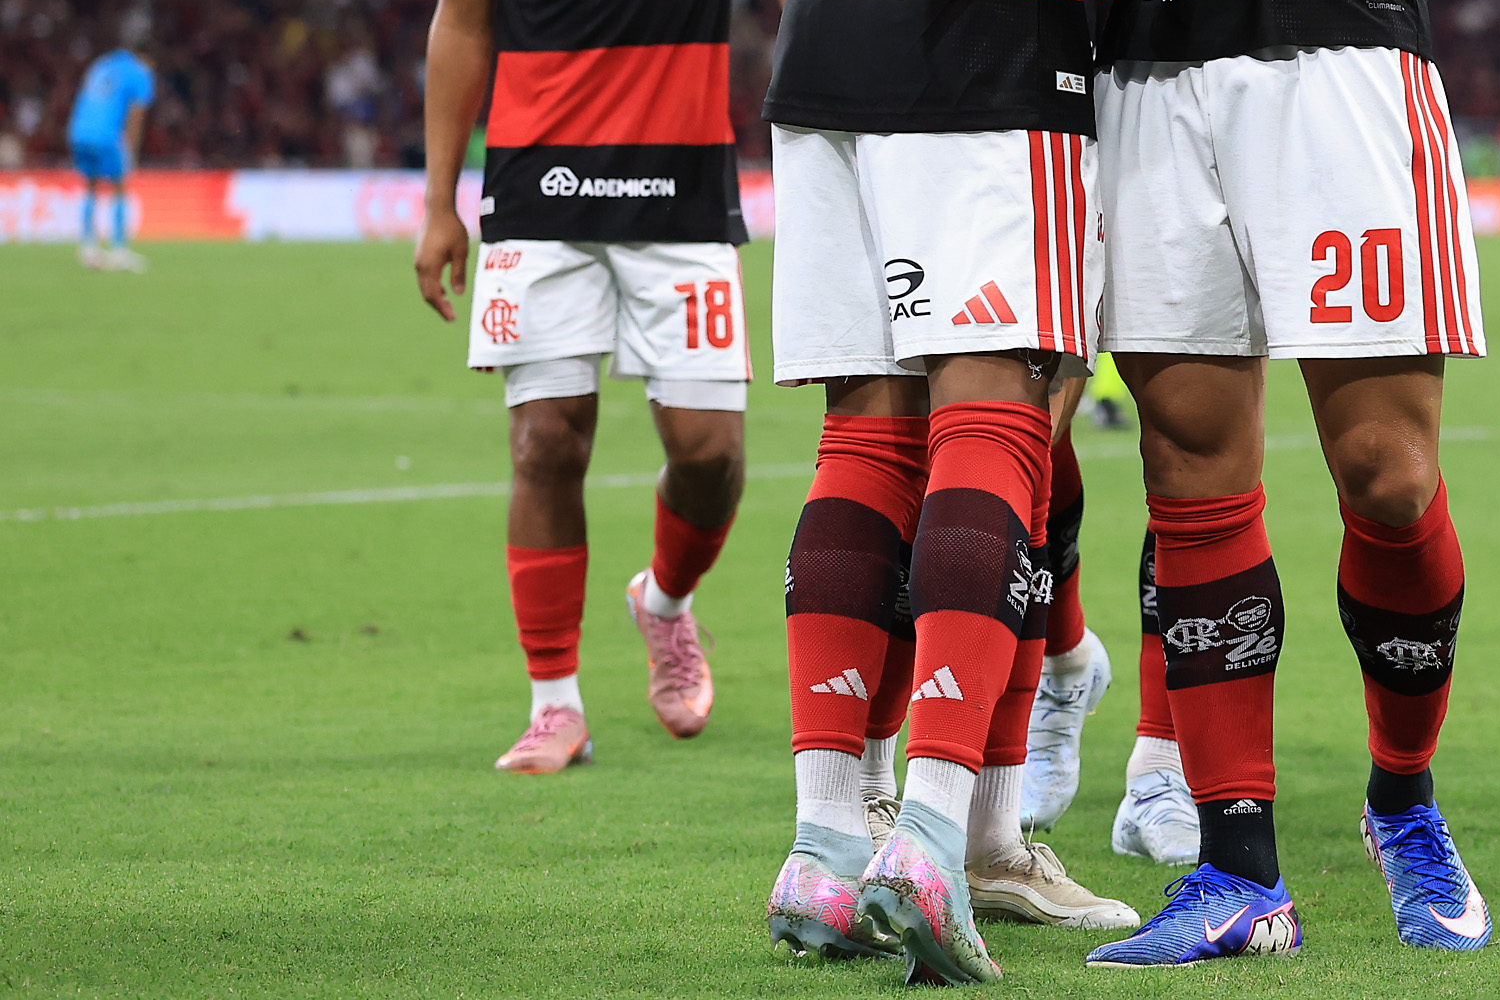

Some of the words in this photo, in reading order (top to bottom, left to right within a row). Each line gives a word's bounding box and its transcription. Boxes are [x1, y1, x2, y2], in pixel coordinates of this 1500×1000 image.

[578, 177, 676, 198] ADEMICON
[484, 247, 522, 274] Wap
[1310, 228, 1405, 324] 20
[675, 280, 734, 350] 18
[1225, 626, 1278, 663] Zé
[1225, 653, 1277, 671] DELIVERY
[1223, 805, 1263, 816] adidas
